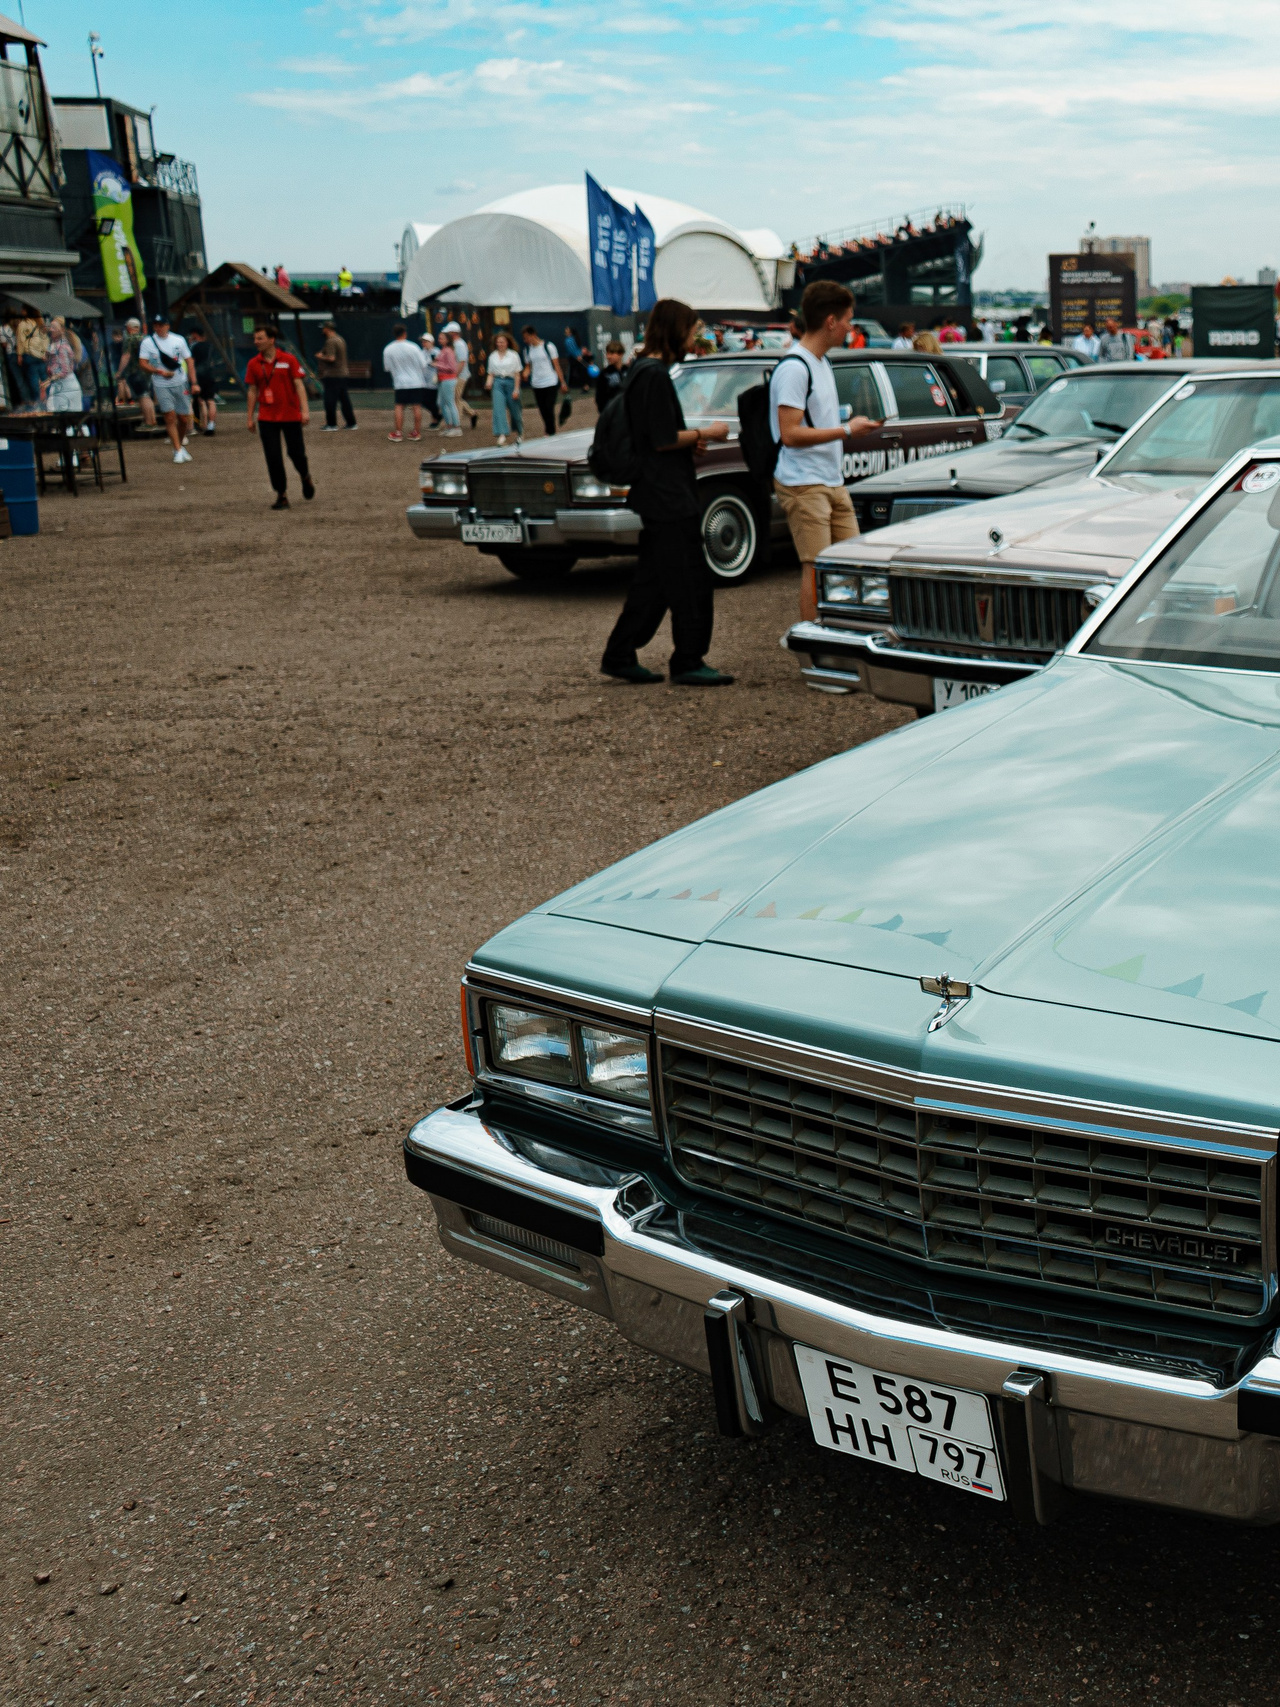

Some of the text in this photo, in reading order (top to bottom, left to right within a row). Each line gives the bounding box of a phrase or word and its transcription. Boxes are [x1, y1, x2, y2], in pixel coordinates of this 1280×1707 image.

[842, 450, 886, 478] ОССИИ
[1105, 1227, 1242, 1263] CHEVROLET
[825, 1360, 957, 1431] Е 587
[825, 1407, 986, 1479] НН 797
[941, 1468, 970, 1486] RUS
